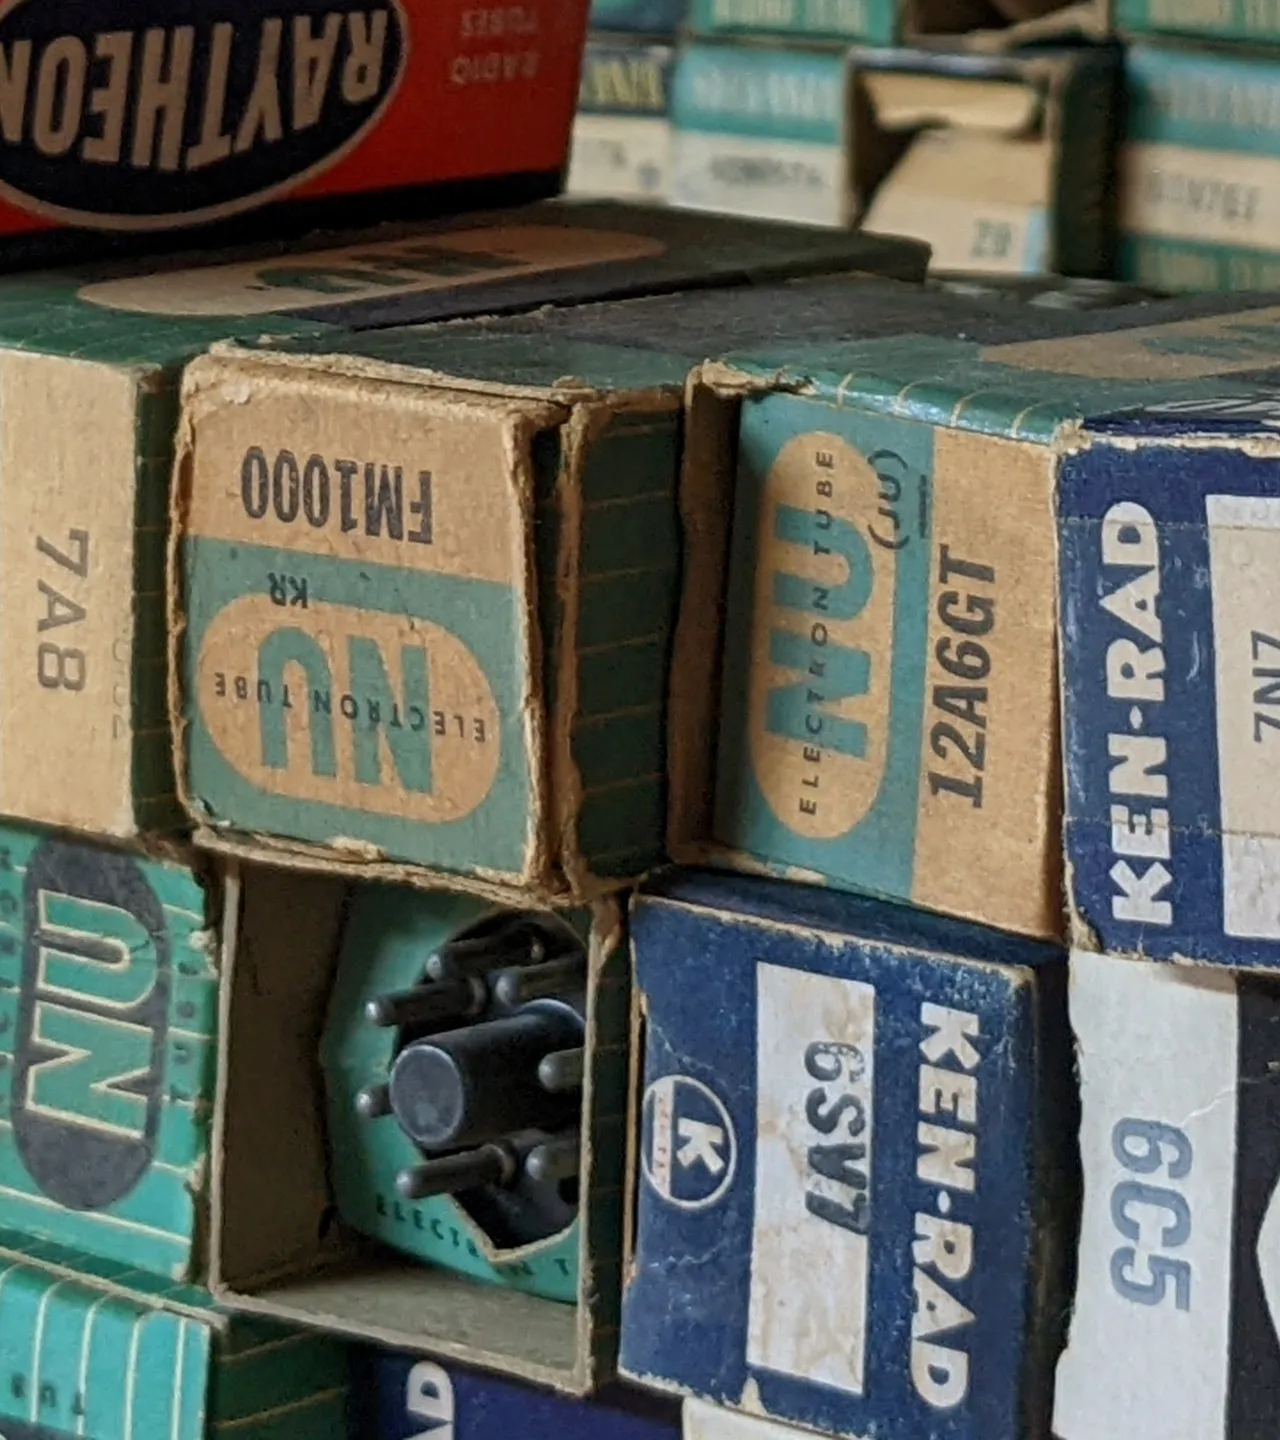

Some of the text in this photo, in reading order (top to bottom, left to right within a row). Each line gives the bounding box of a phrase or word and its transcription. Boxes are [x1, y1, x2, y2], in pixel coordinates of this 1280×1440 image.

[239, 445, 434, 545] FM1000
[35, 527, 90, 693] 7A8
[212, 670, 488, 744] ELECTRON TUBE
[764, 503, 874, 758] NU
[796, 448, 835, 815] ELECTRON TUBE
[928, 543, 996, 809] 12A6GT
[257, 624, 434, 795] NU
[25, 889, 159, 1142] NU
[805, 1040, 873, 1236] 6SV7
[1109, 1114, 1193, 1313] 6C5
